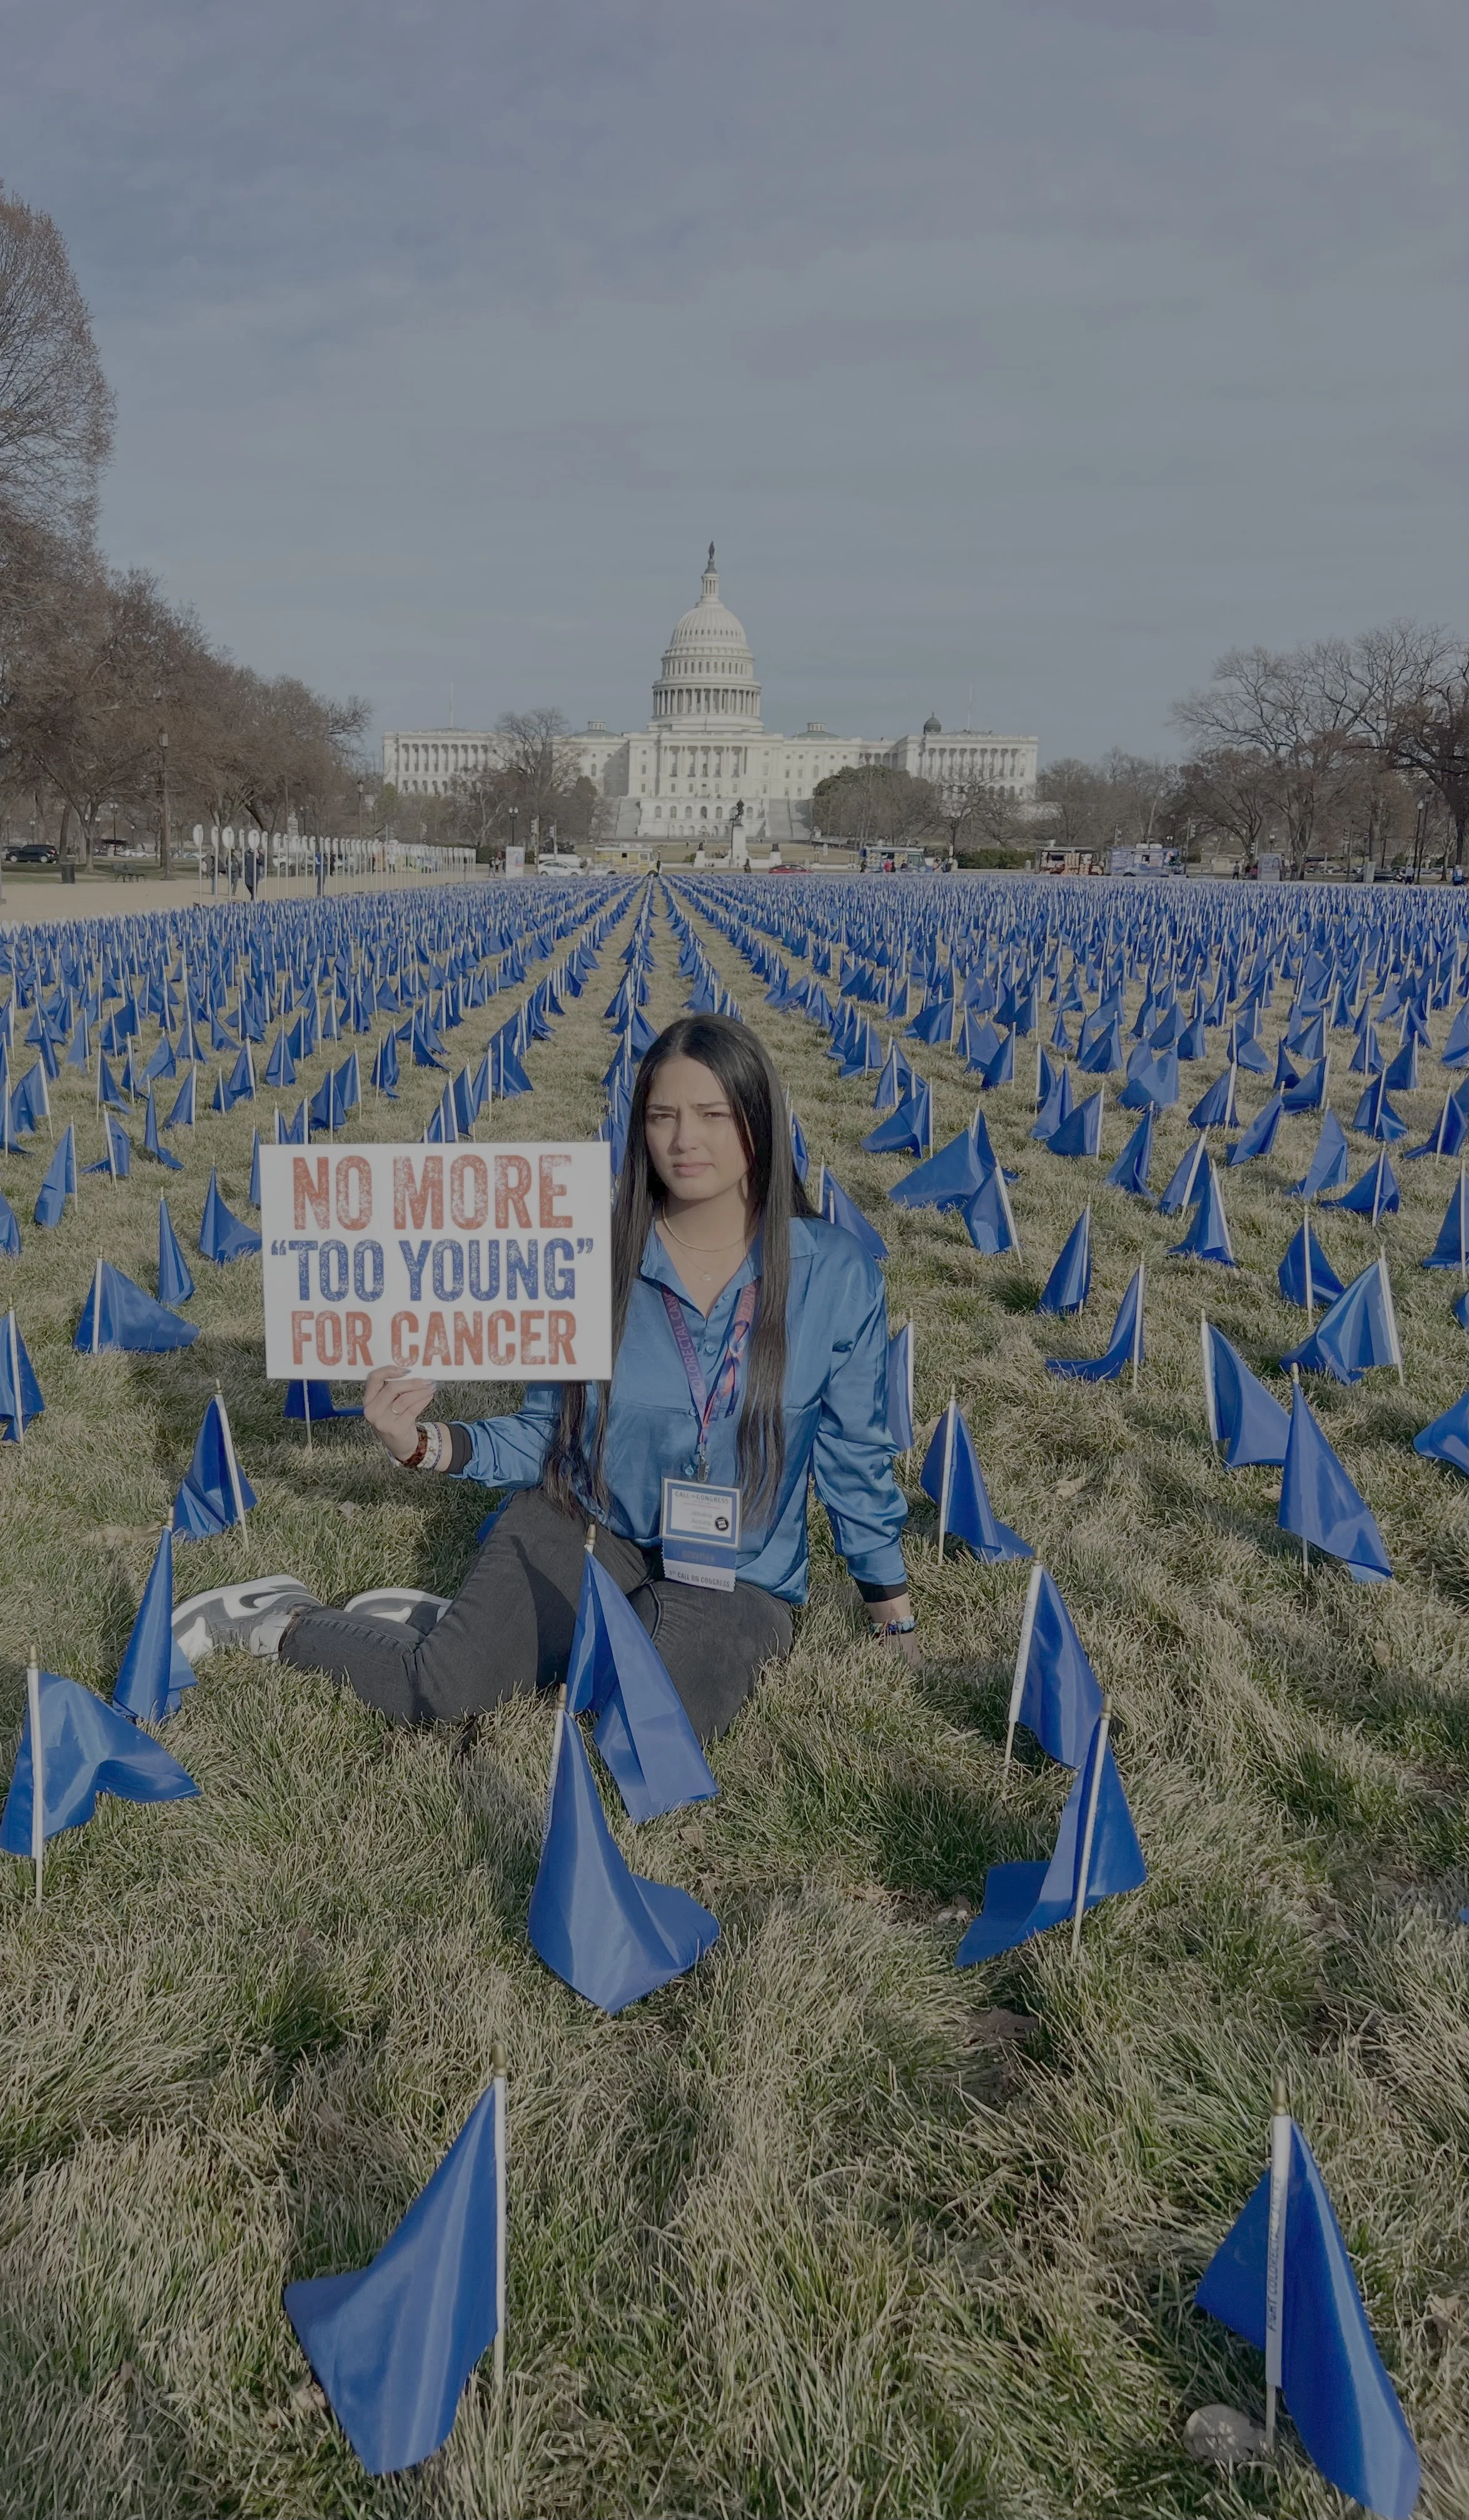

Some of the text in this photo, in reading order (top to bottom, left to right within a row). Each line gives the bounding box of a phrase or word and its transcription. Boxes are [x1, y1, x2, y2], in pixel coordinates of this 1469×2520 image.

[293, 1155, 573, 1230] NO MORE
[291, 1310, 577, 1367] FOR CANCER
[675, 1322, 705, 1396] COLORECTAL
[675, 1490, 730, 1505] CALL CONGRESS
[677, 1572, 690, 1581] CALL
[700, 1577, 730, 1587] CONGRESS
[1268, 2297, 1278, 2332] FIGHT
